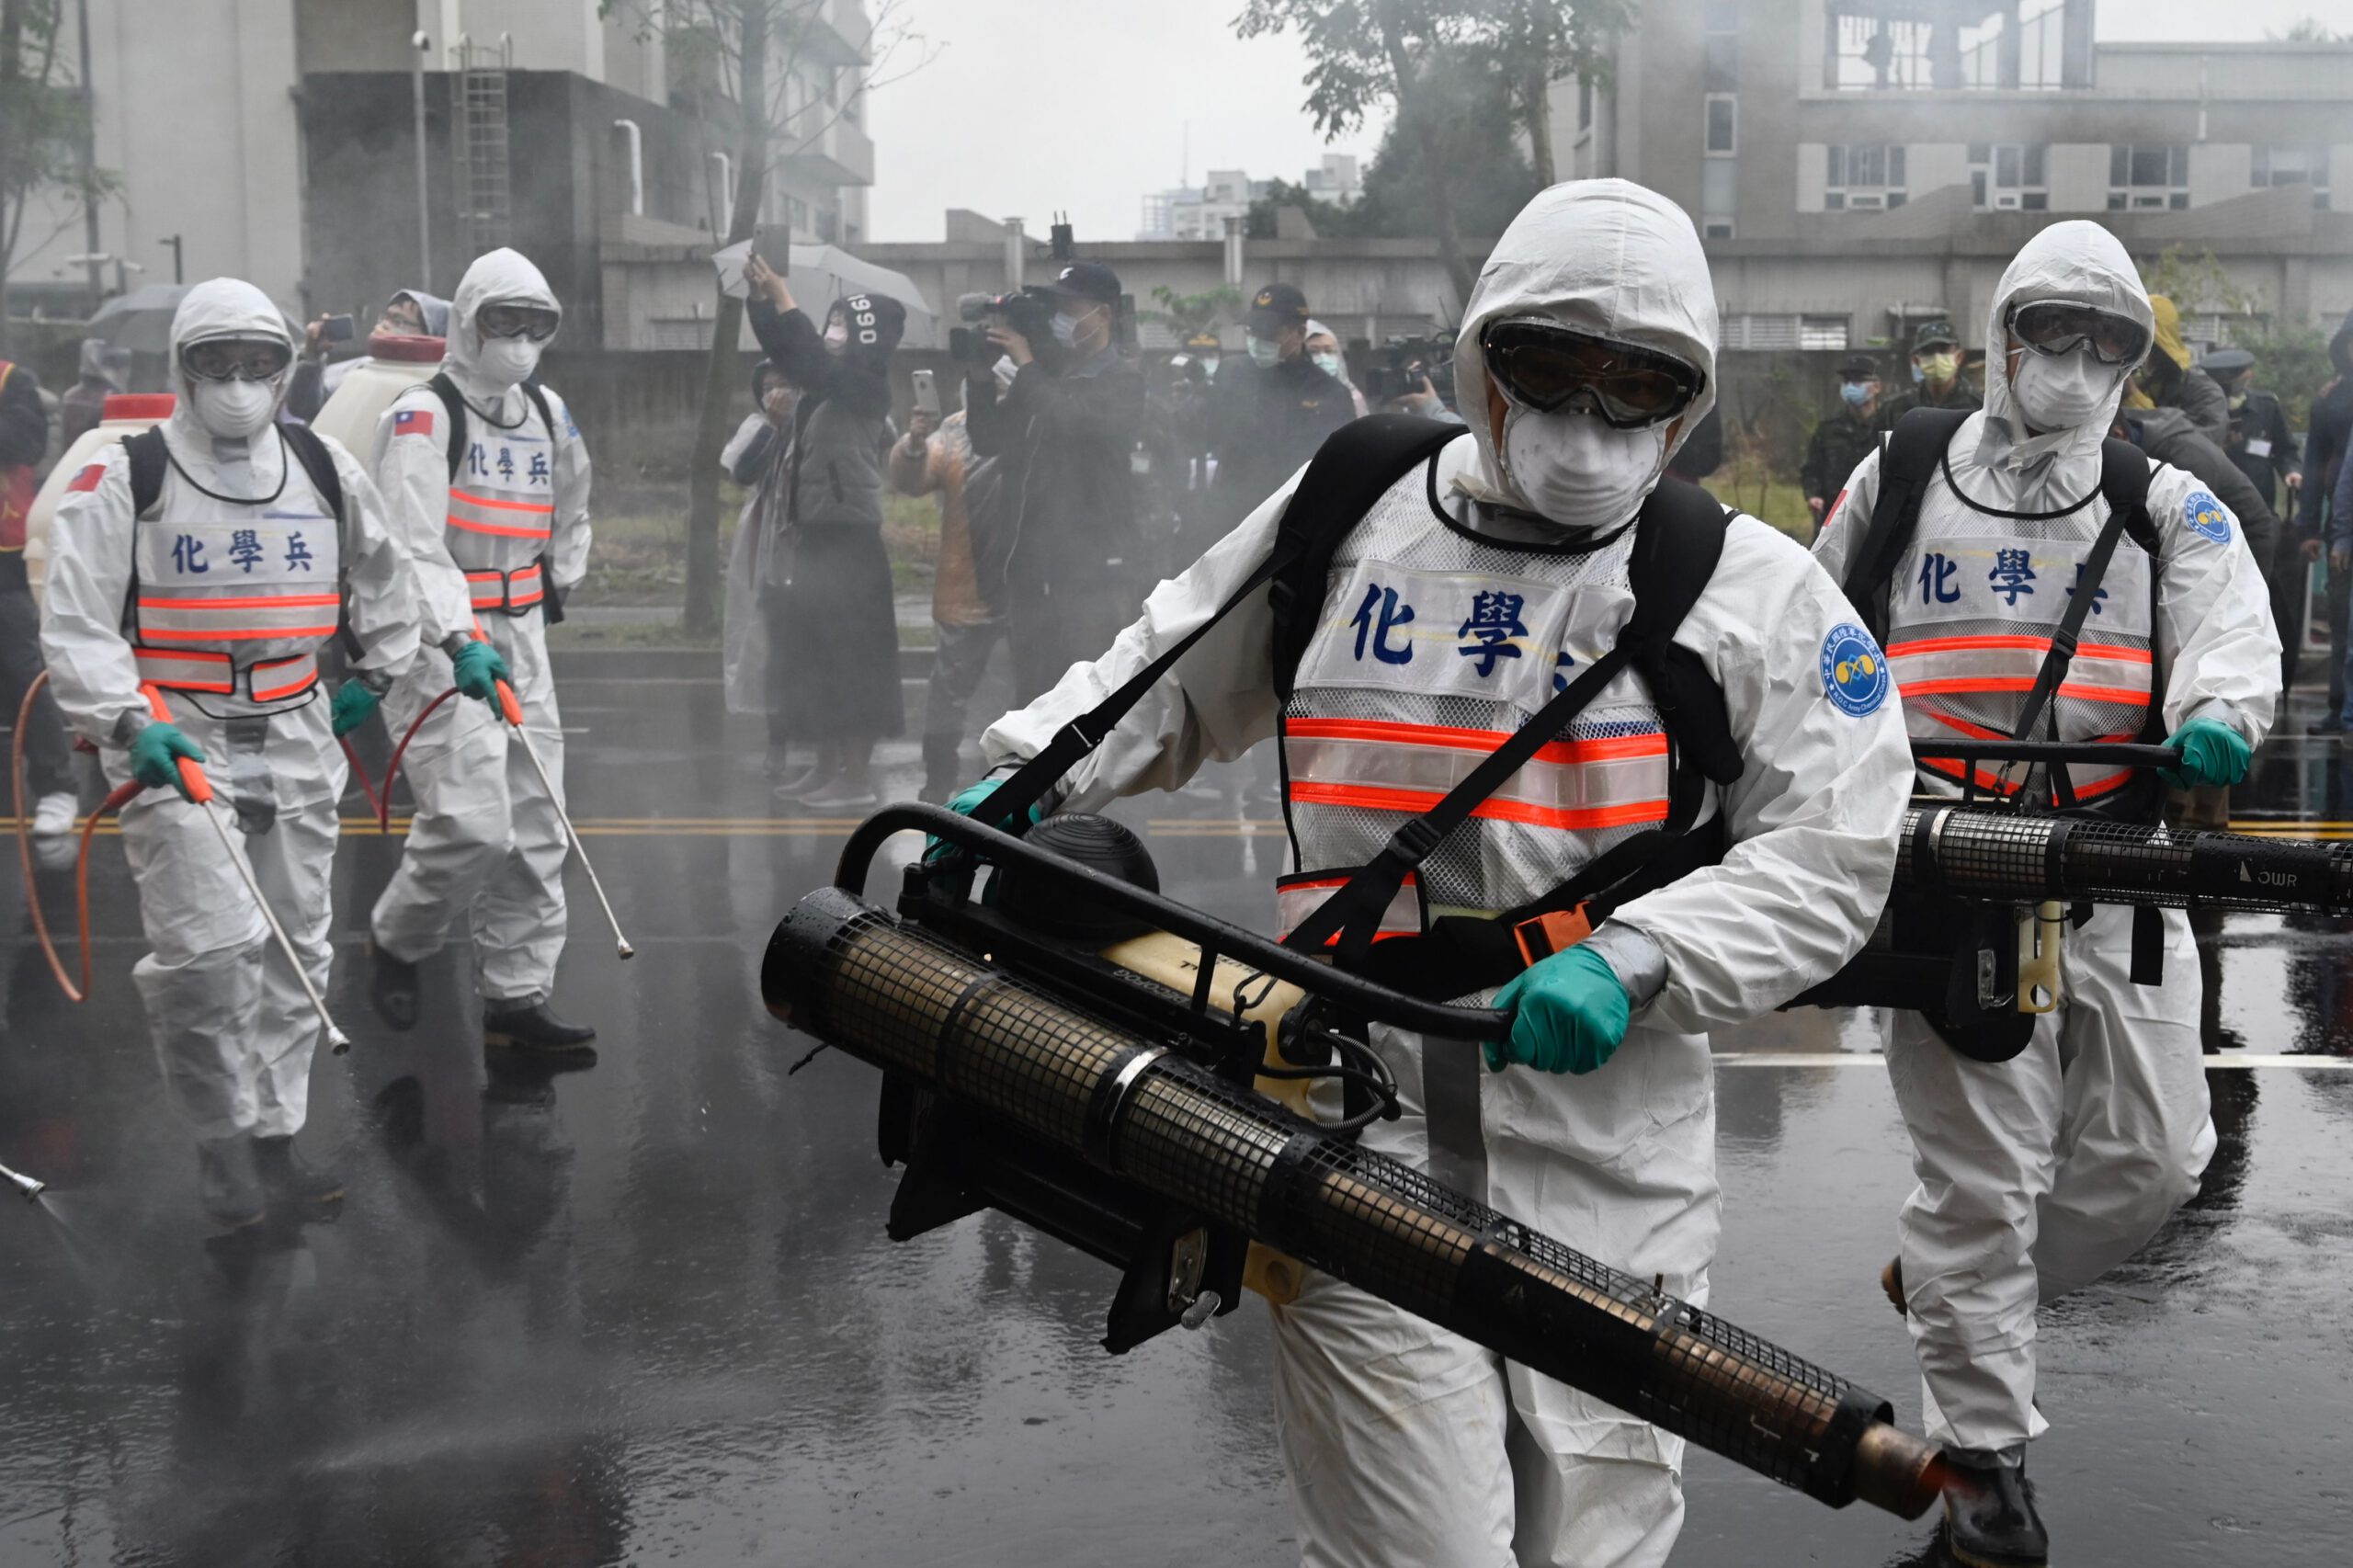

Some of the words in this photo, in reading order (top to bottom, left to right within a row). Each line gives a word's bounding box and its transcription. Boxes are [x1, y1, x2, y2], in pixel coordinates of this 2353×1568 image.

[467, 442, 549, 485] 化學兵
[171, 529, 313, 574] 化學兵
[1349, 583, 1574, 692] 化學
[1847, 703, 1861, 712] Army
